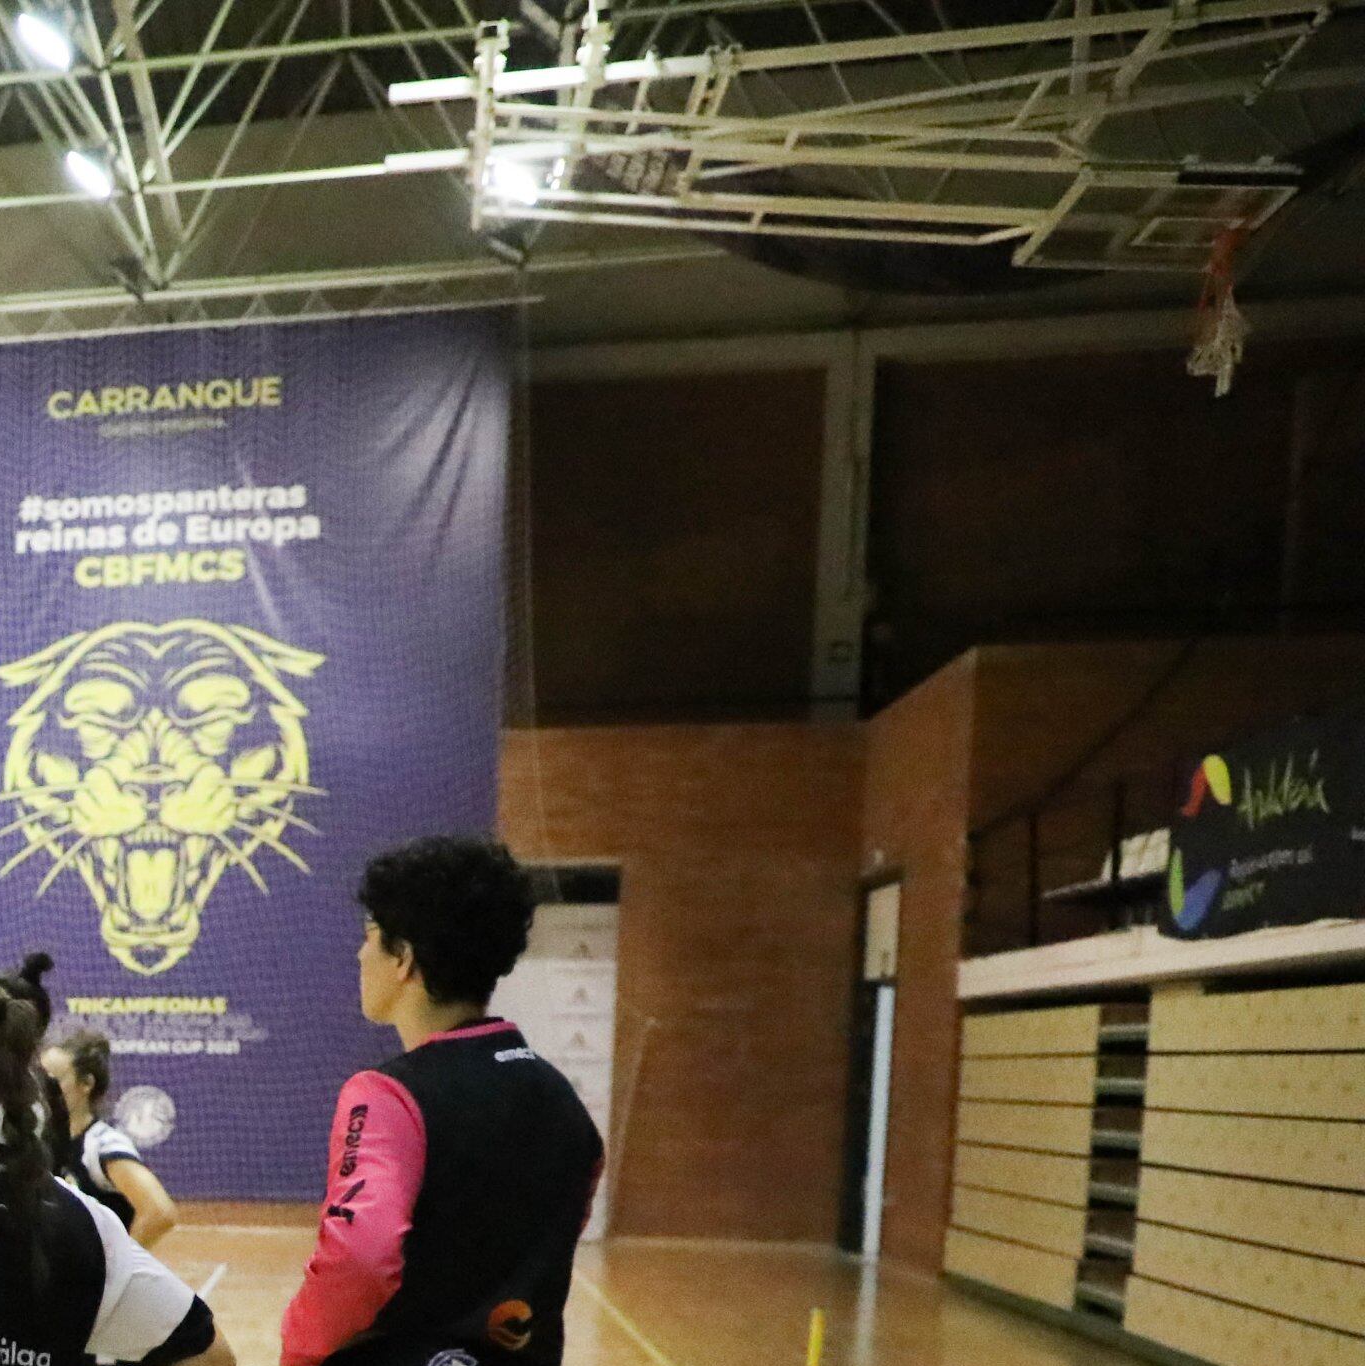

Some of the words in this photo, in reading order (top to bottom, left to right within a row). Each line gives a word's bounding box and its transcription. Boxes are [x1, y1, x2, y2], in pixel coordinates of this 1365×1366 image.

[47, 376, 282, 419] CARRANQUE
[20, 485, 306, 522] #somospanteras
[15, 520, 126, 554] reinas
[131, 517, 180, 547] de
[185, 514, 320, 547] Europa
[74, 550, 247, 588] CBFMCS
[66, 996, 229, 1014] TRICAMPEONAS
